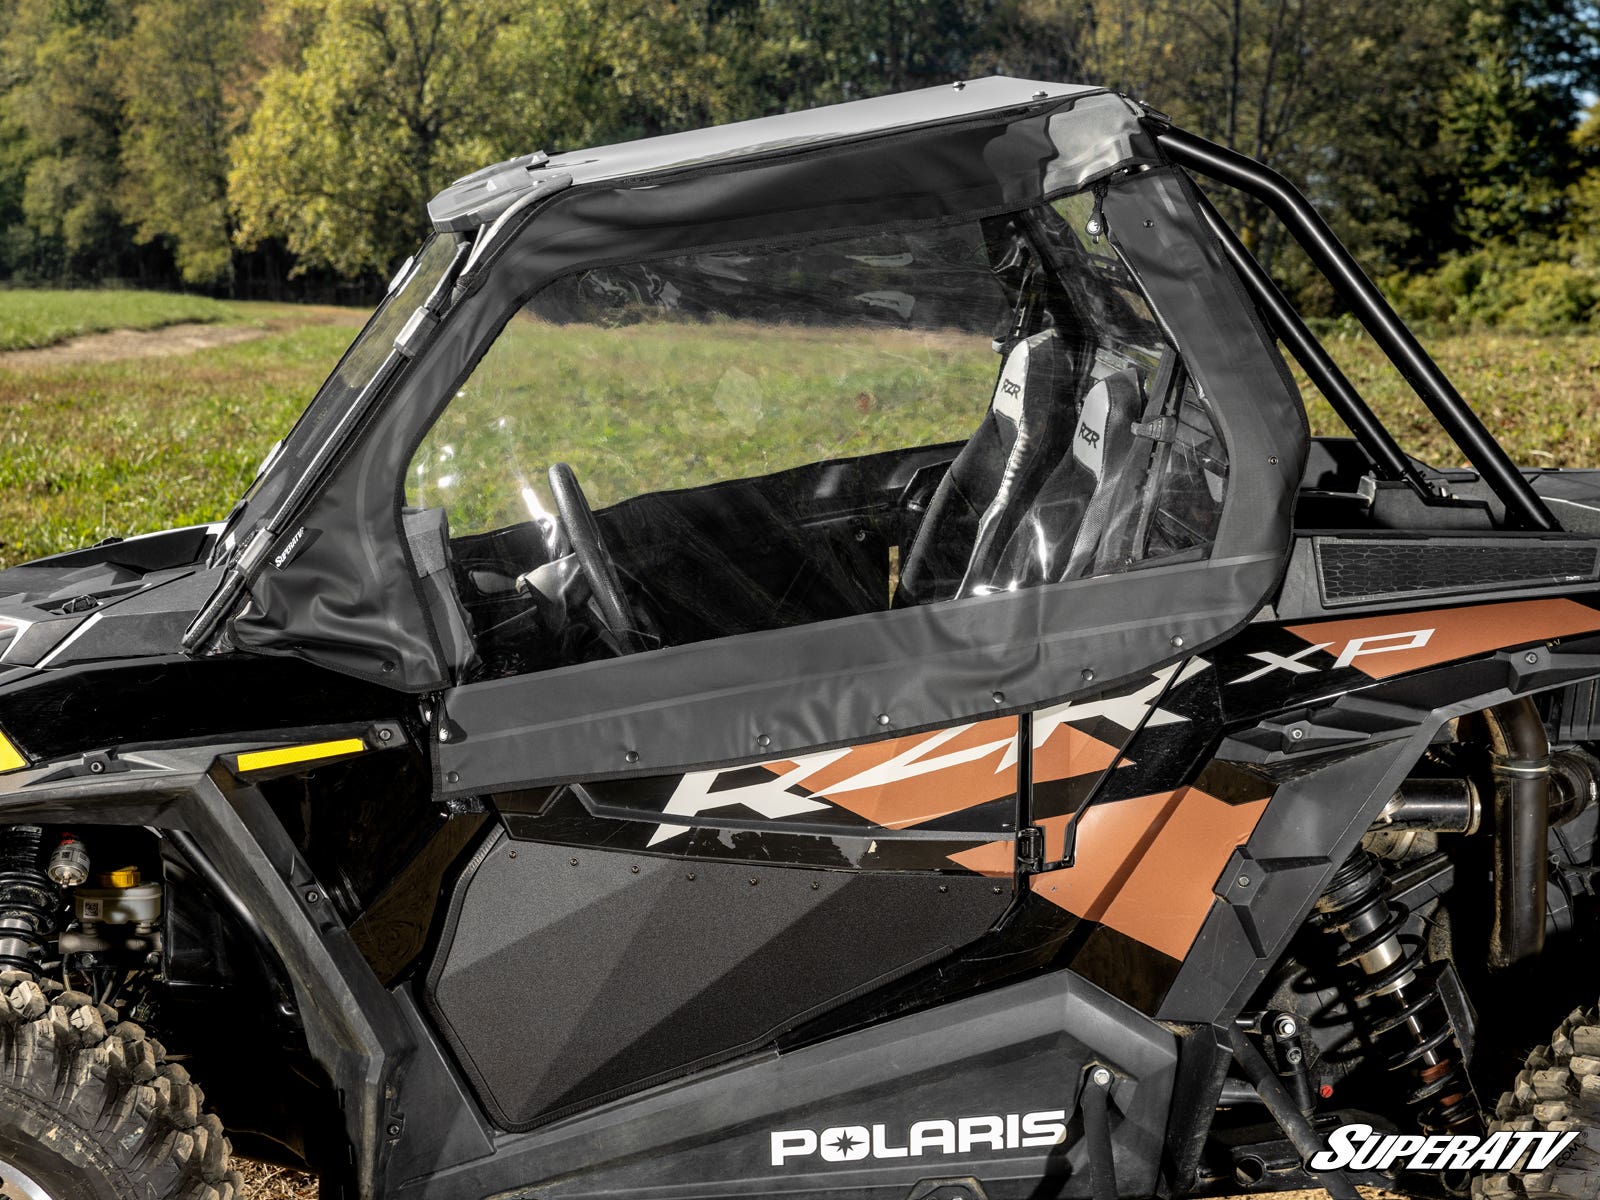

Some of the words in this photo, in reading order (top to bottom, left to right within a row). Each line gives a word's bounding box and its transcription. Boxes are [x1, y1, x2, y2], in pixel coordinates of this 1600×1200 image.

[1002, 379, 1021, 399] RZR
[1079, 421, 1100, 449] RZR
[646, 655, 1212, 847] RZR
[1224, 628, 1436, 685] XP
[770, 1110, 1067, 1166] POLARIS
